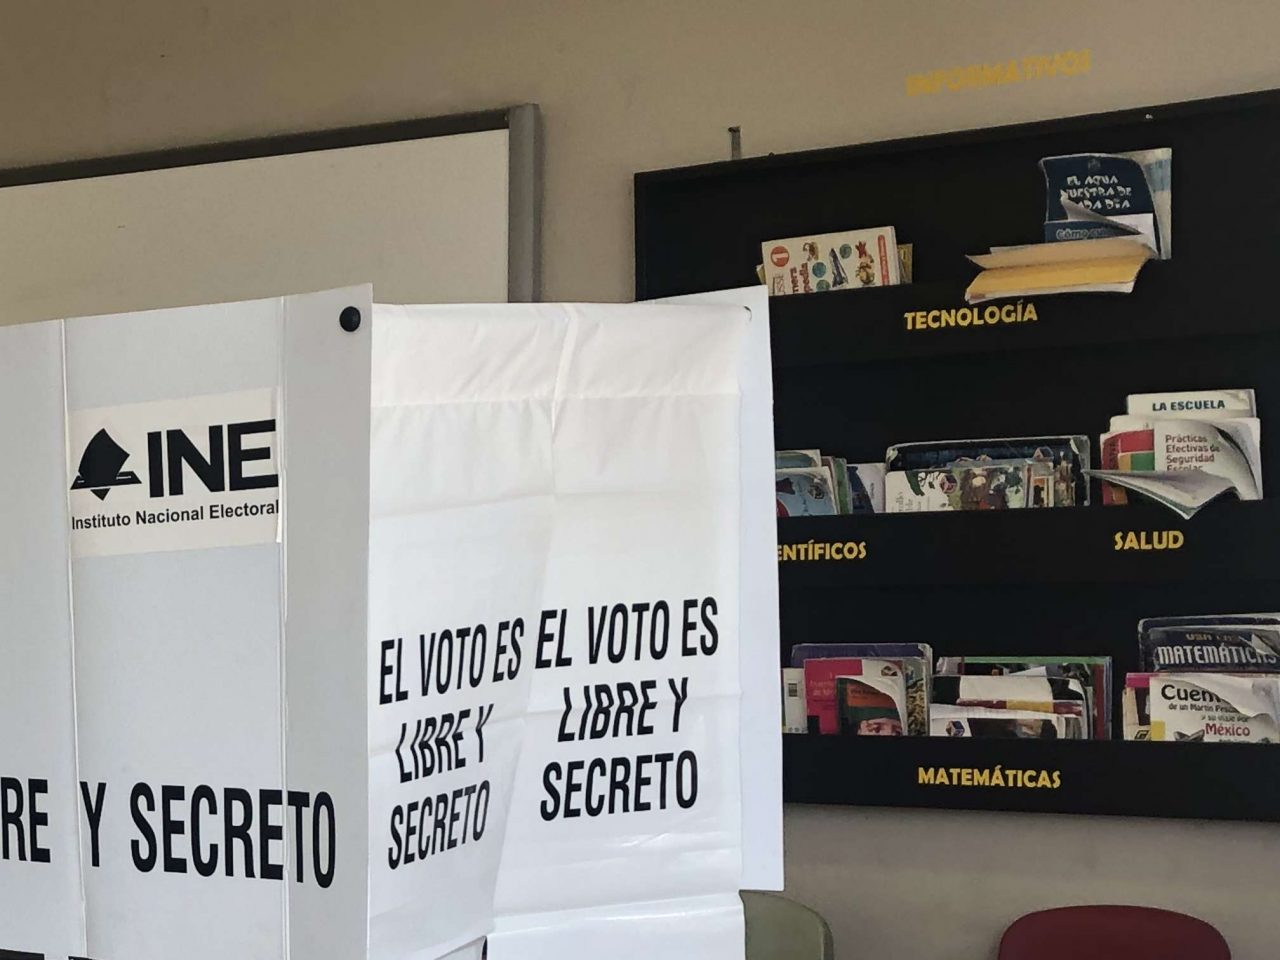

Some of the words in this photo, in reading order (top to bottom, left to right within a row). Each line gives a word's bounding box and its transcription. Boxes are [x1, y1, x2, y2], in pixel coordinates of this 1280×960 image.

[906, 49, 1092, 97] INFORMATIVOS
[1066, 175, 1081, 186] EL
[904, 299, 1038, 330] TECNOLOGÍA
[1152, 402, 1167, 412] LA
[1170, 400, 1226, 411] ESCUELA
[1165, 434, 1208, 444] Prácticas
[1165, 444, 1208, 454] Efectivas
[146, 418, 279, 498] INE
[1166, 453, 1215, 465] Seguridad
[71, 513, 131, 530] Instituto
[136, 505, 204, 526] Nacional
[209, 499, 279, 520] Electoral
[1114, 530, 1184, 551] SALUD
[535, 608, 572, 669] EL
[587, 600, 670, 664] VOTO
[681, 596, 719, 657] ES
[379, 637, 408, 705] EL
[419, 623, 487, 697] VOTO
[492, 617, 524, 683] ES
[557, 679, 657, 743] LIBRE
[668, 677, 689, 733] Y
[395, 708, 471, 783] LIBRE
[475, 703, 494, 763] Y
[1205, 722, 1251, 737] México
[540, 750, 699, 821] SECRETO
[918, 765, 1061, 788] MATEMÁTICAS
[79, 781, 107, 868] Y
[129, 781, 336, 889] SECRETO
[388, 780, 490, 870] SECRETO
